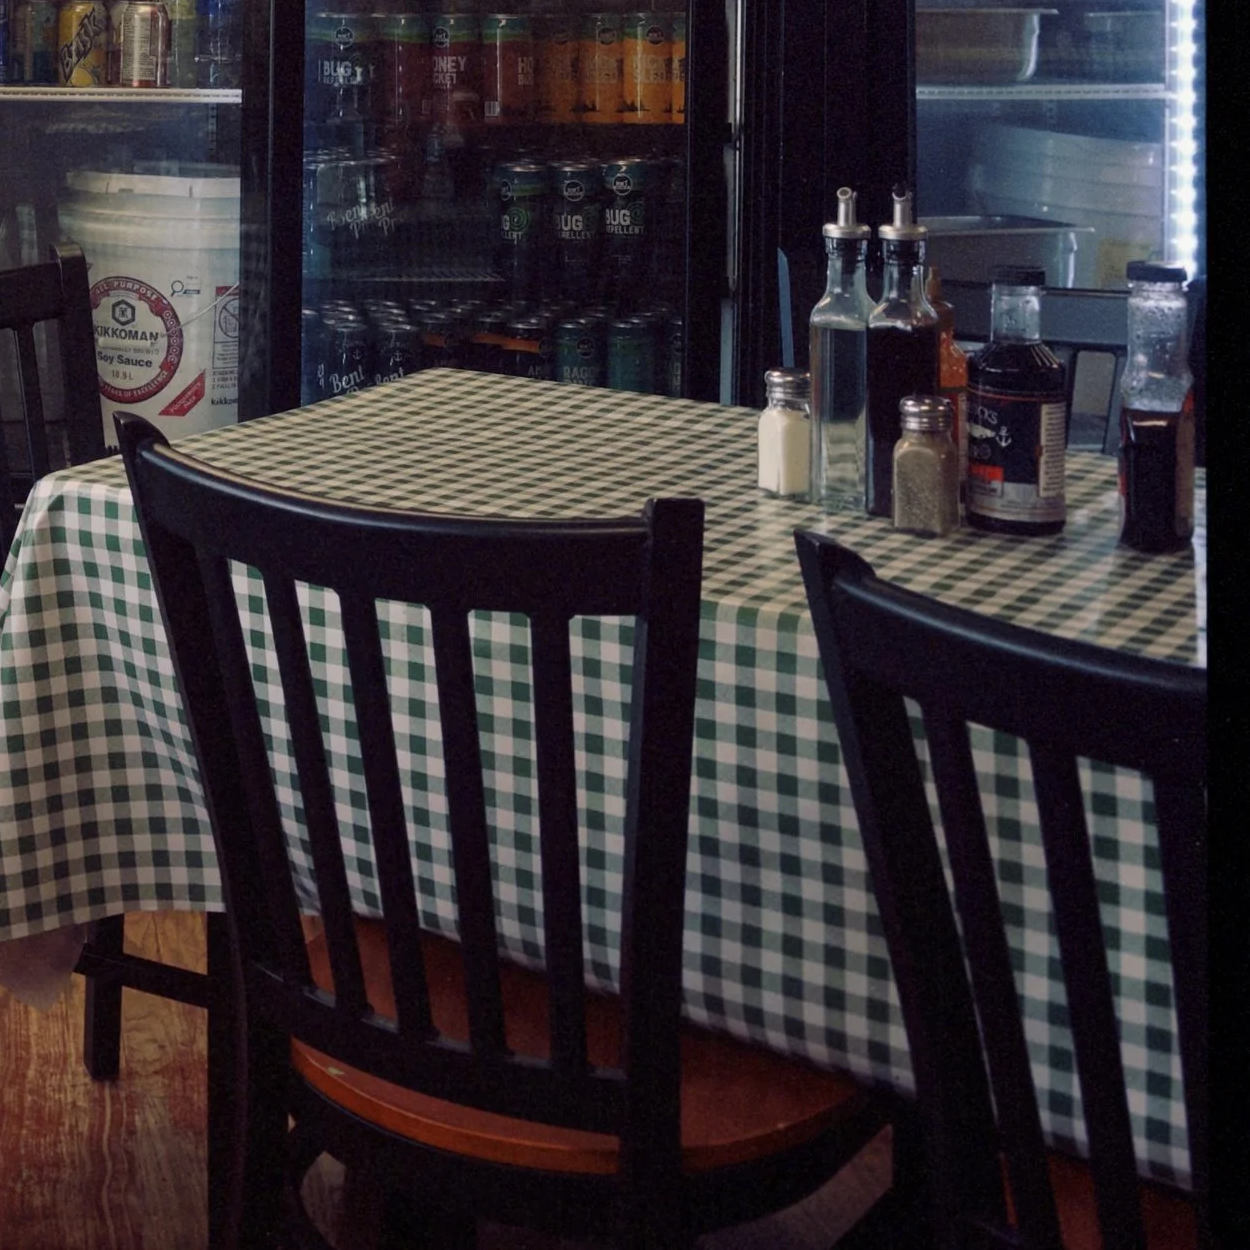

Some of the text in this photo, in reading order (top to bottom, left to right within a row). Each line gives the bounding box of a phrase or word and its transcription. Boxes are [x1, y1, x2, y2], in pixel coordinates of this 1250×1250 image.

[433, 72, 458, 84] CKET
[605, 208, 631, 225] BUG
[113, 280, 160, 301] PURPOSE
[94, 327, 160, 341] KIKKOMAN
[97, 351, 153, 368] Soy Sauce
